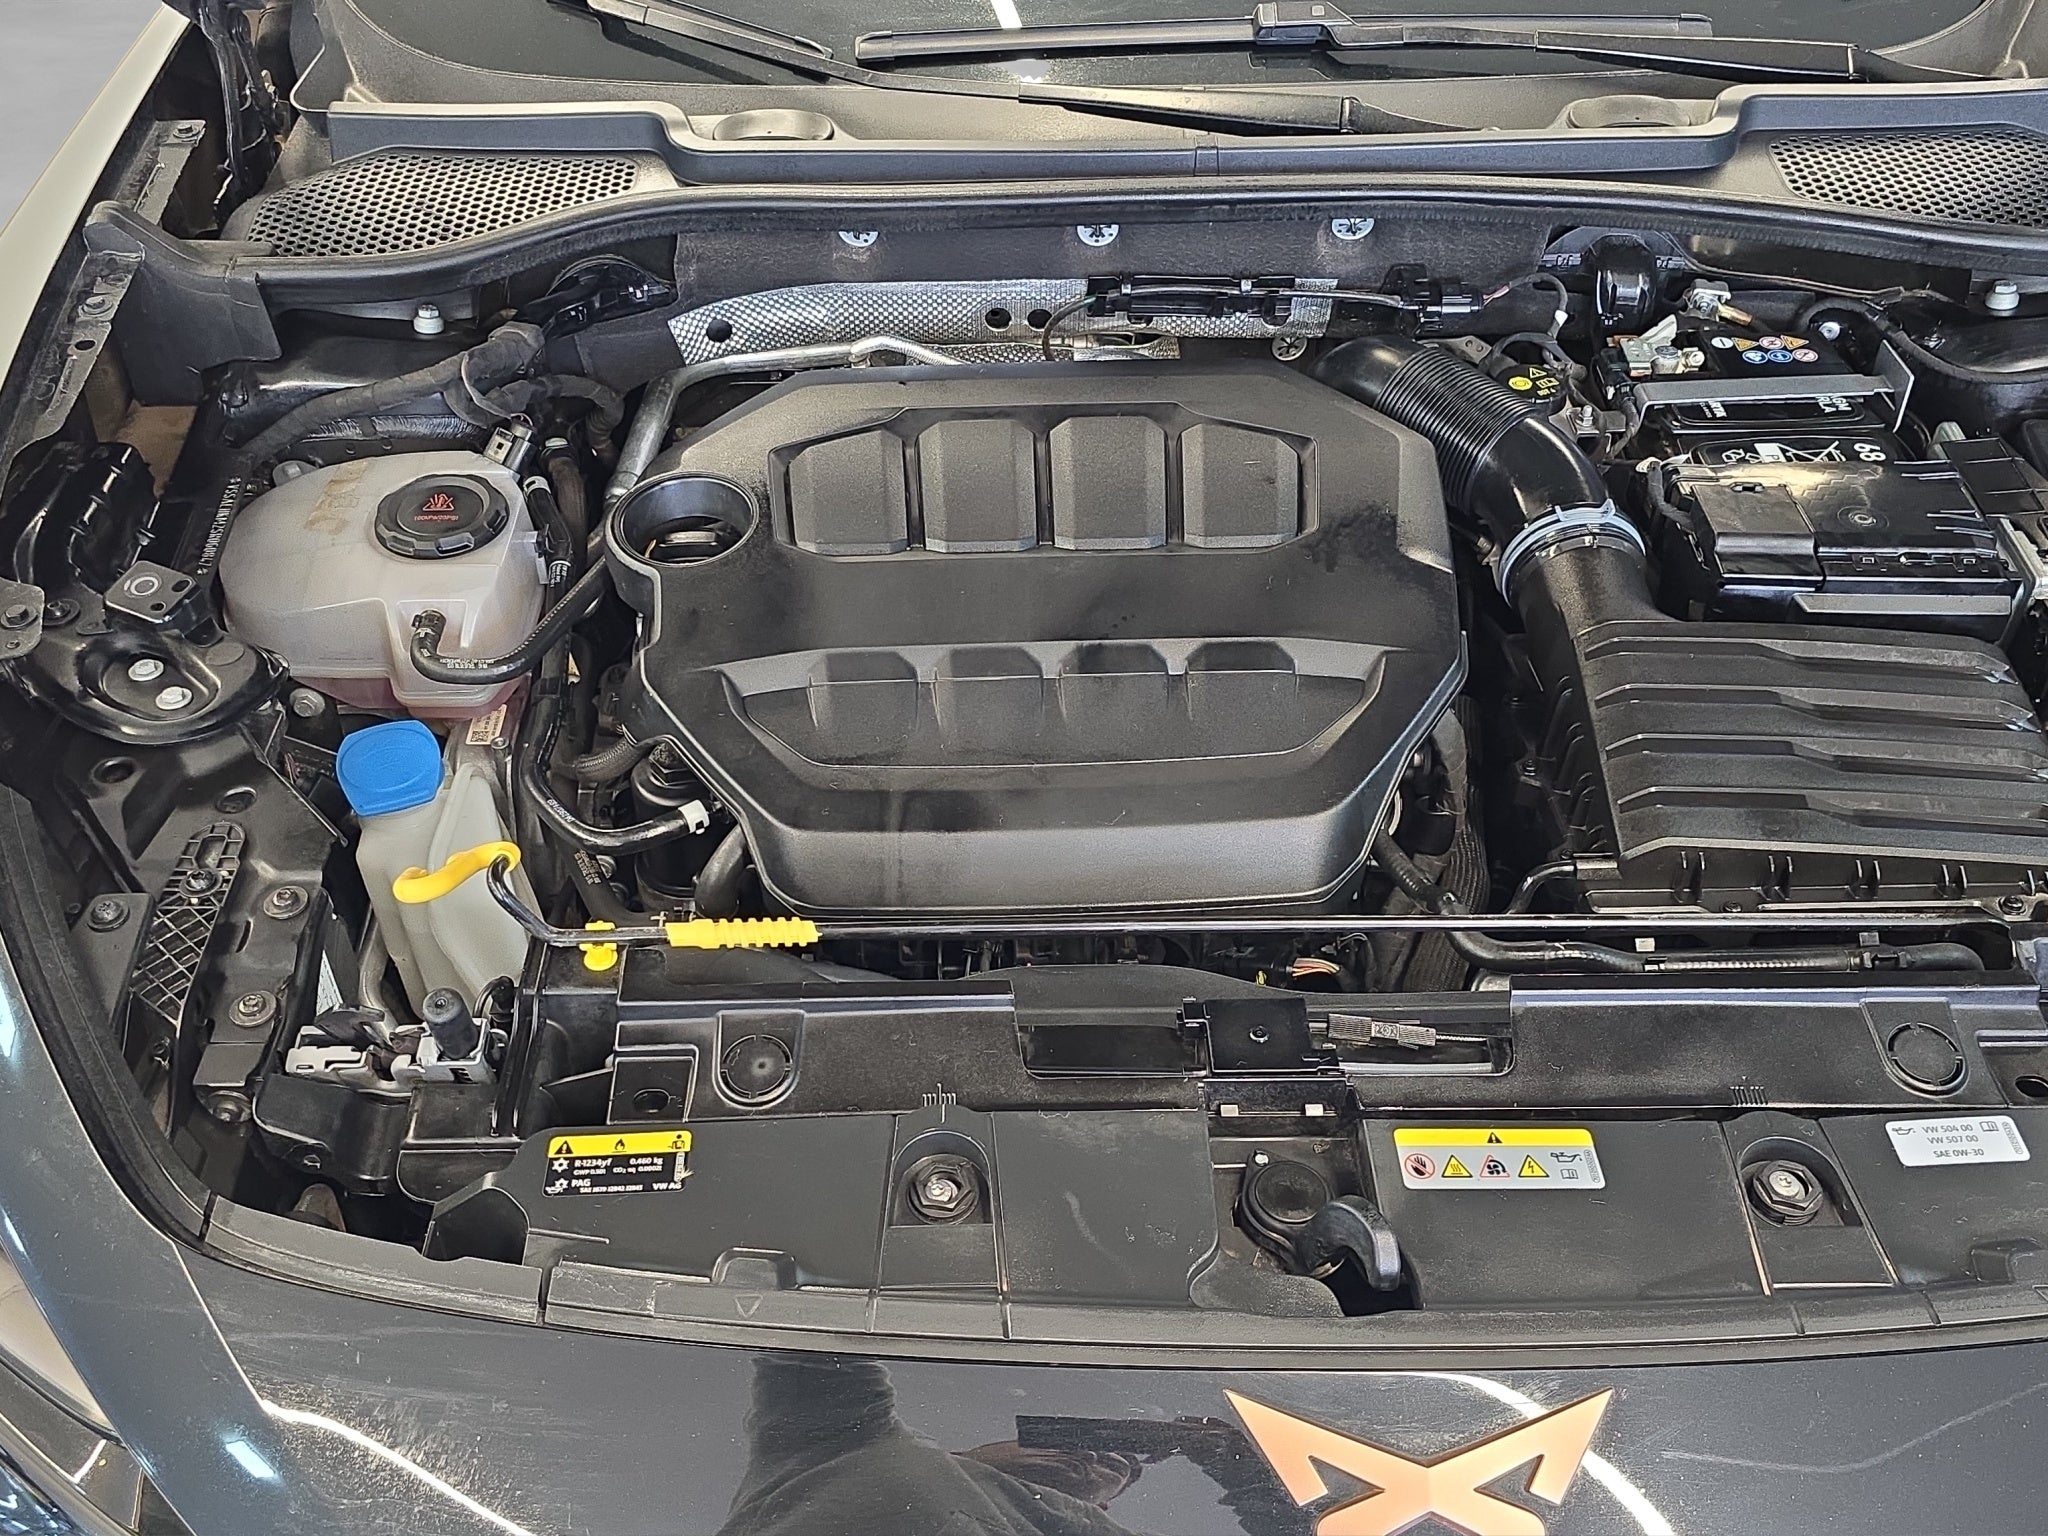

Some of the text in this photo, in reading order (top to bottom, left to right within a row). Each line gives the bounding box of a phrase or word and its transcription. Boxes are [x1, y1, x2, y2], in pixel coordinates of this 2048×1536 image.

[1708, 401, 1728, 418] RTA
[1815, 396, 1837, 413] RLA
[1853, 442, 1887, 462] 68
[1926, 1134, 1979, 1144] VW 507 00
[1933, 1148, 1985, 1158] SAE 0W-30
[574, 1157, 664, 1169] R-1234yf 0.460 kg
[571, 1178, 591, 1187] PAG
[652, 1181, 682, 1191] VW AG
